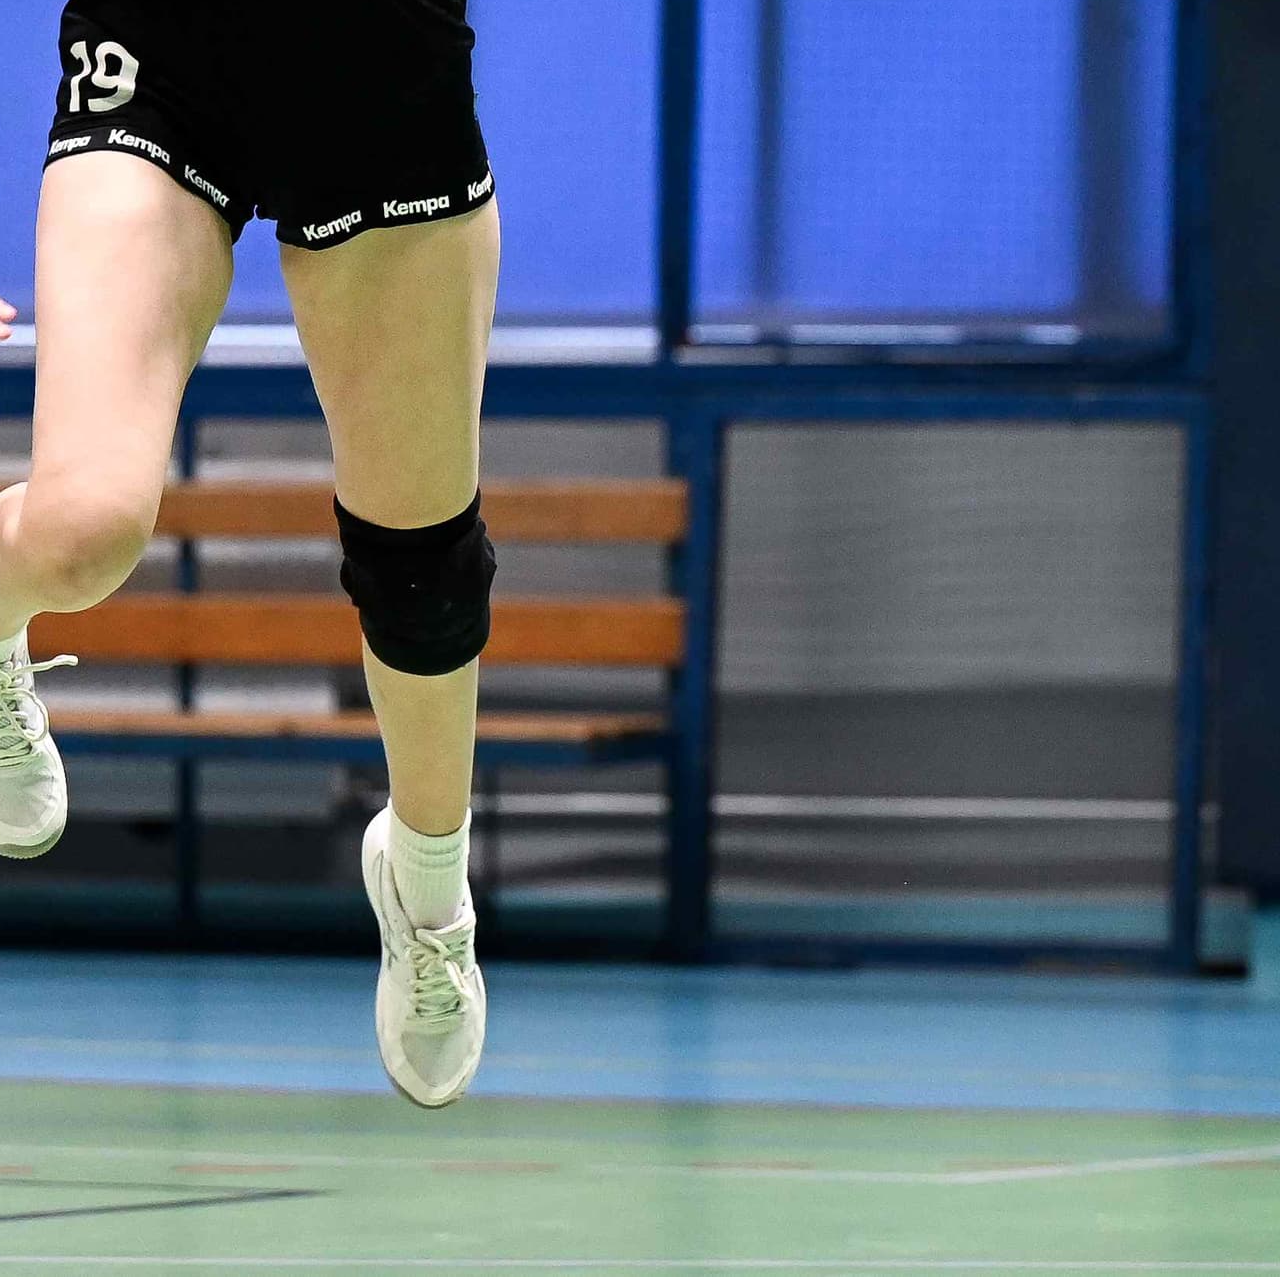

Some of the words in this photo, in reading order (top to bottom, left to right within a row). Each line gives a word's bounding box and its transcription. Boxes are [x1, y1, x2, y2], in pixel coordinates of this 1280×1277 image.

[69, 40, 140, 113] 19
[48, 135, 92, 156] Kempa
[108, 128, 171, 165] Kempa
[184, 164, 230, 208] Kempa
[302, 209, 363, 242] Kempa
[382, 194, 451, 219] Kempa
